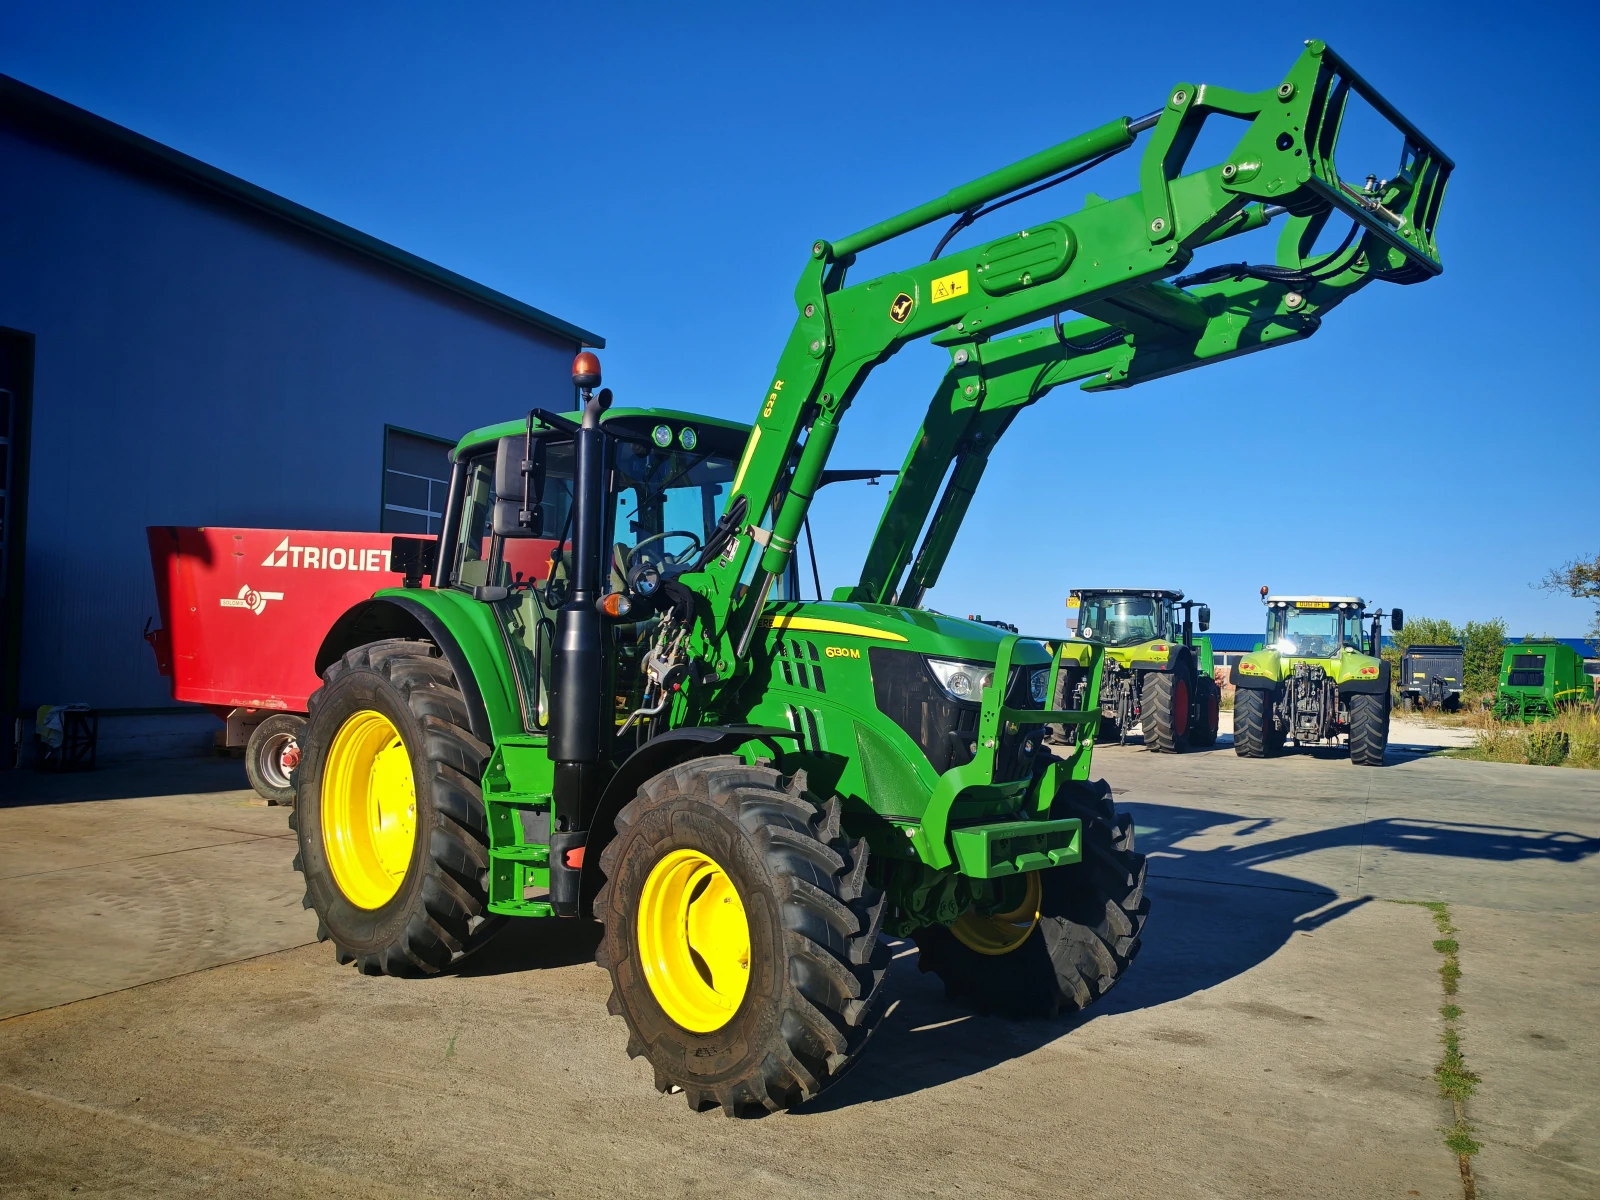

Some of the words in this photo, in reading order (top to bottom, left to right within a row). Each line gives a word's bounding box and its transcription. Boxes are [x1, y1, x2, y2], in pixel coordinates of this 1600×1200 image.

[763, 392, 777, 418] 623
[774, 380, 785, 391] R
[289, 546, 392, 572] TRIOLIET
[757, 618, 774, 627] ERE
